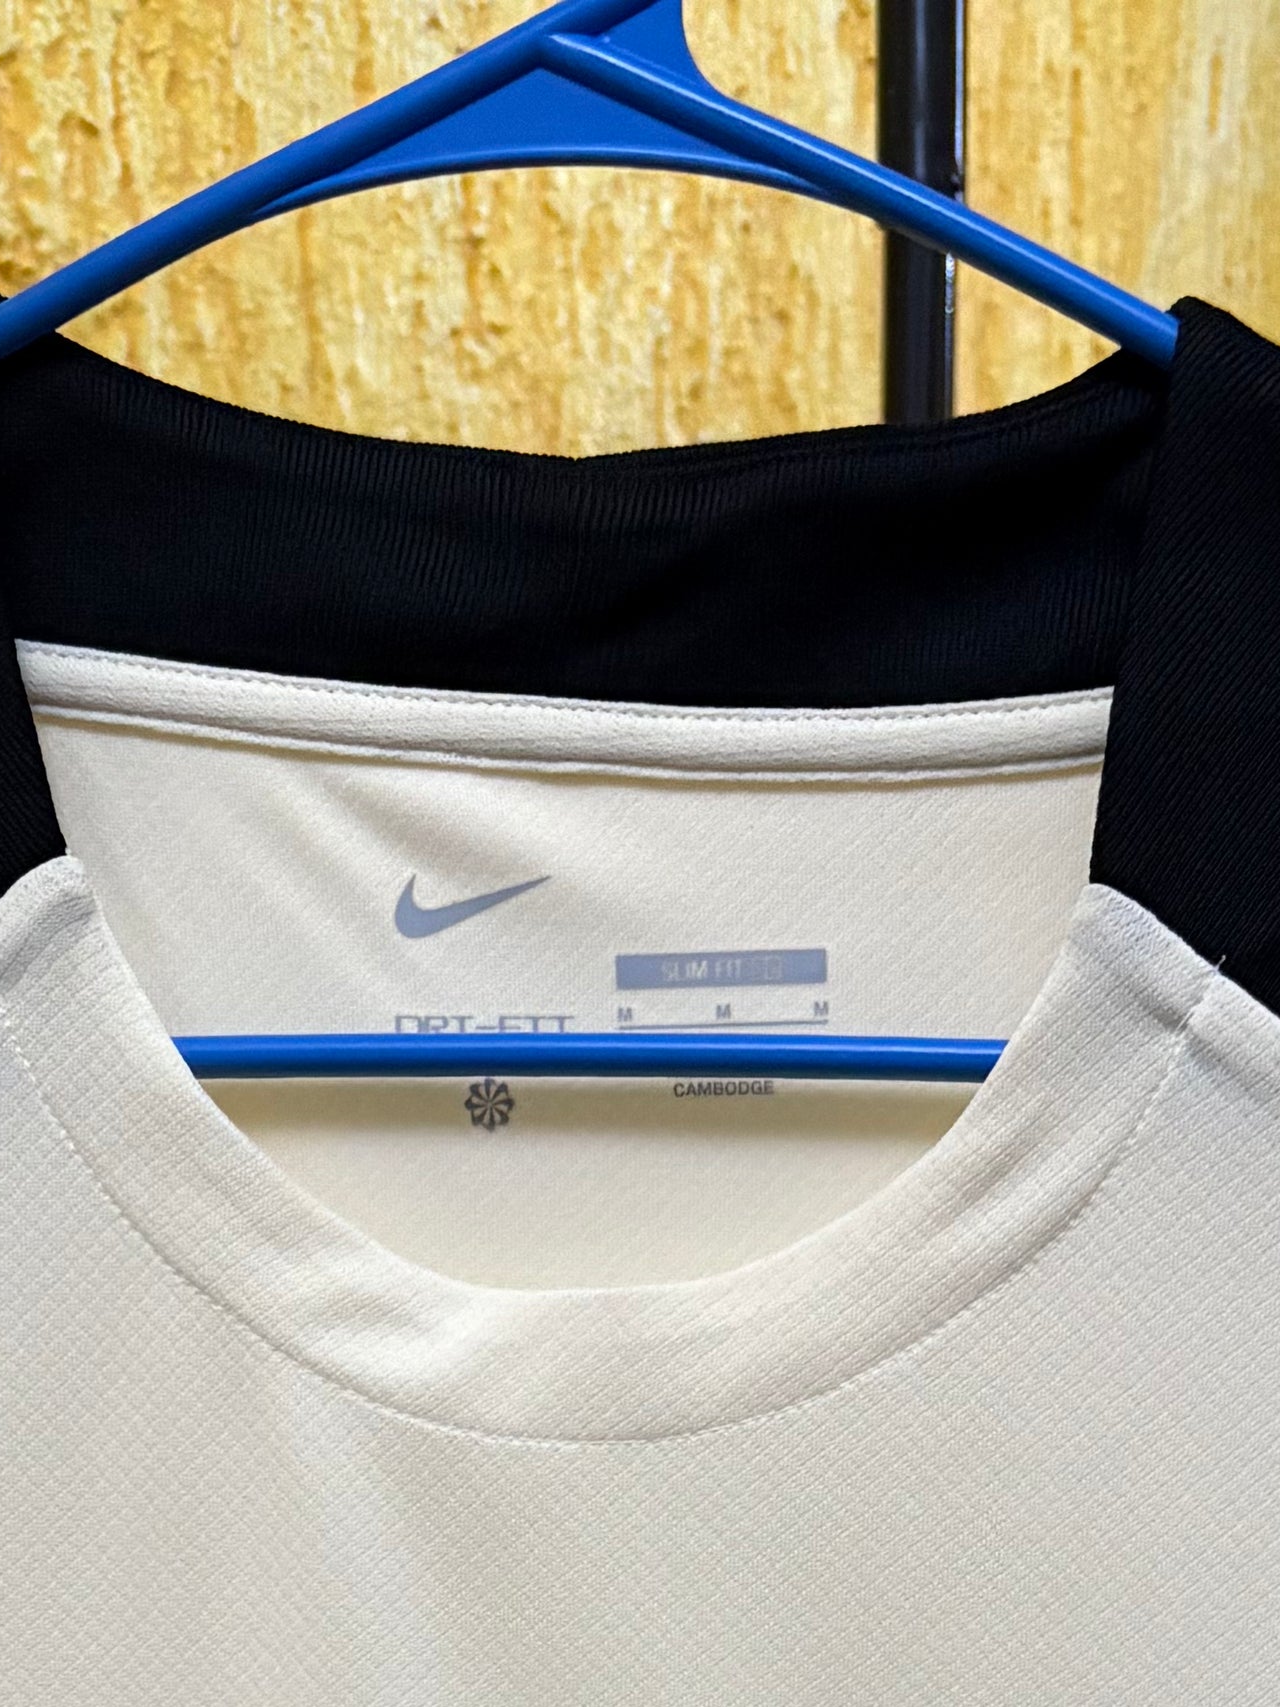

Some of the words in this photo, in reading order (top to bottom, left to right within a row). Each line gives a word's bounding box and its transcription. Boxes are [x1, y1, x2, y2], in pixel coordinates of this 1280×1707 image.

[661, 959, 708, 981] SLIM
[715, 957, 742, 979] FIT
[618, 1007, 633, 1022] M
[716, 1003, 731, 1019] M
[813, 1001, 829, 1016] M
[673, 1080, 774, 1098] CAMBODGE
